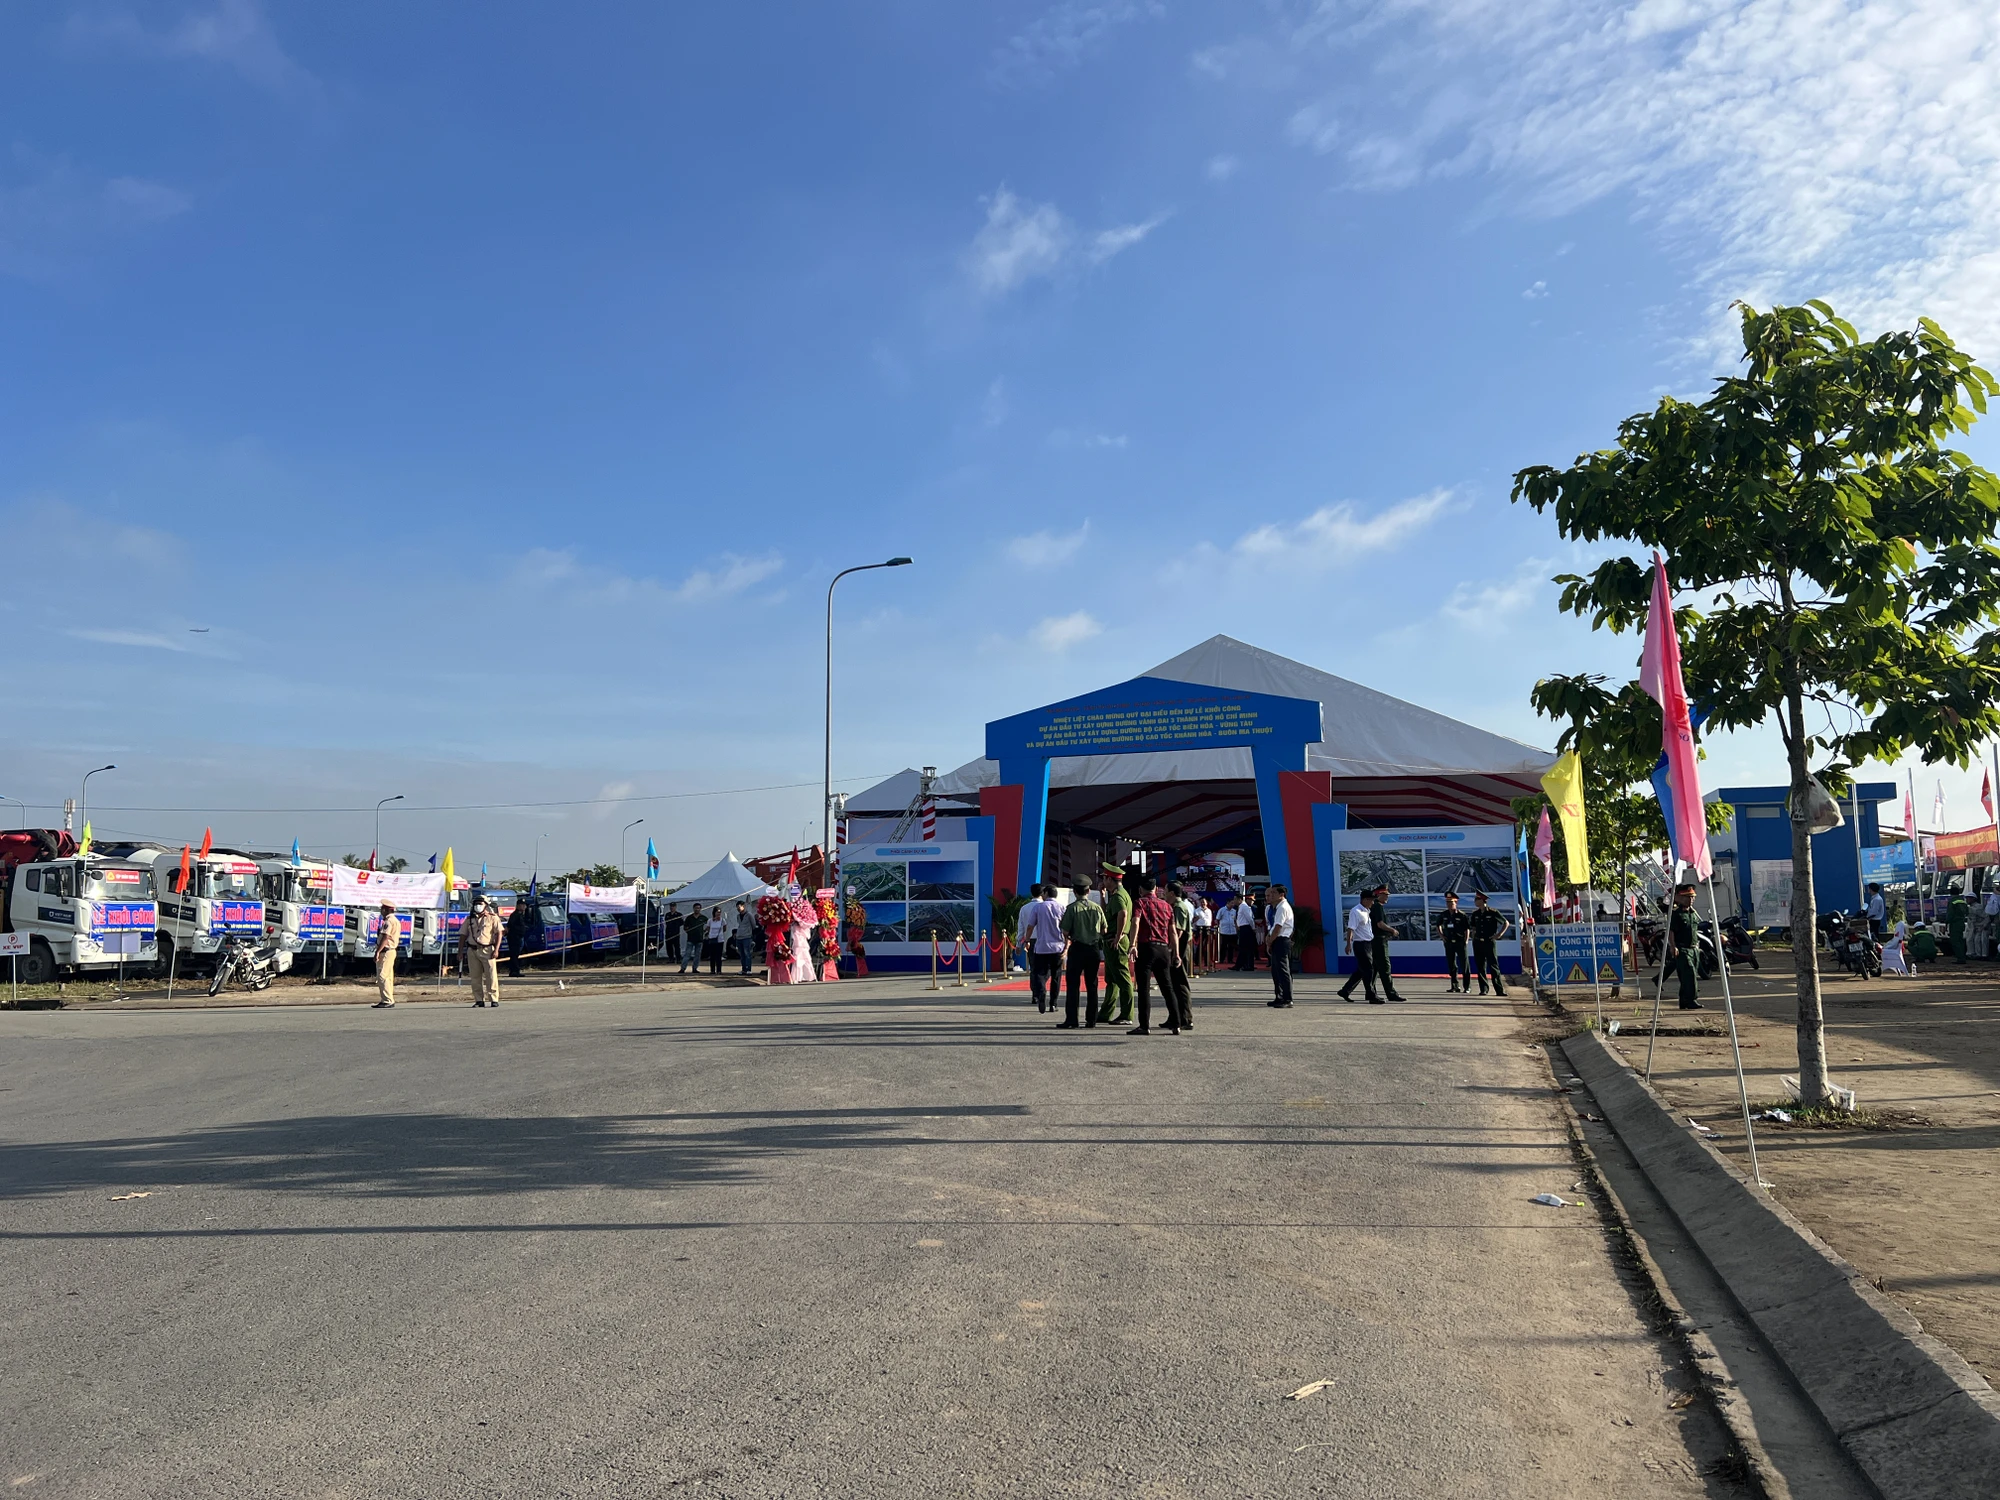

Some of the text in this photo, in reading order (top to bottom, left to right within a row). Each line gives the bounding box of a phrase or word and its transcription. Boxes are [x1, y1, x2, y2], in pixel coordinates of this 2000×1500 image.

[1205, 705, 1220, 713] KHỞI
[108, 906, 130, 924] KHỞI
[225, 904, 243, 921] KHỞI
[1560, 936, 1581, 945] CÔNG
[1597, 947, 1618, 956] CÔNG
